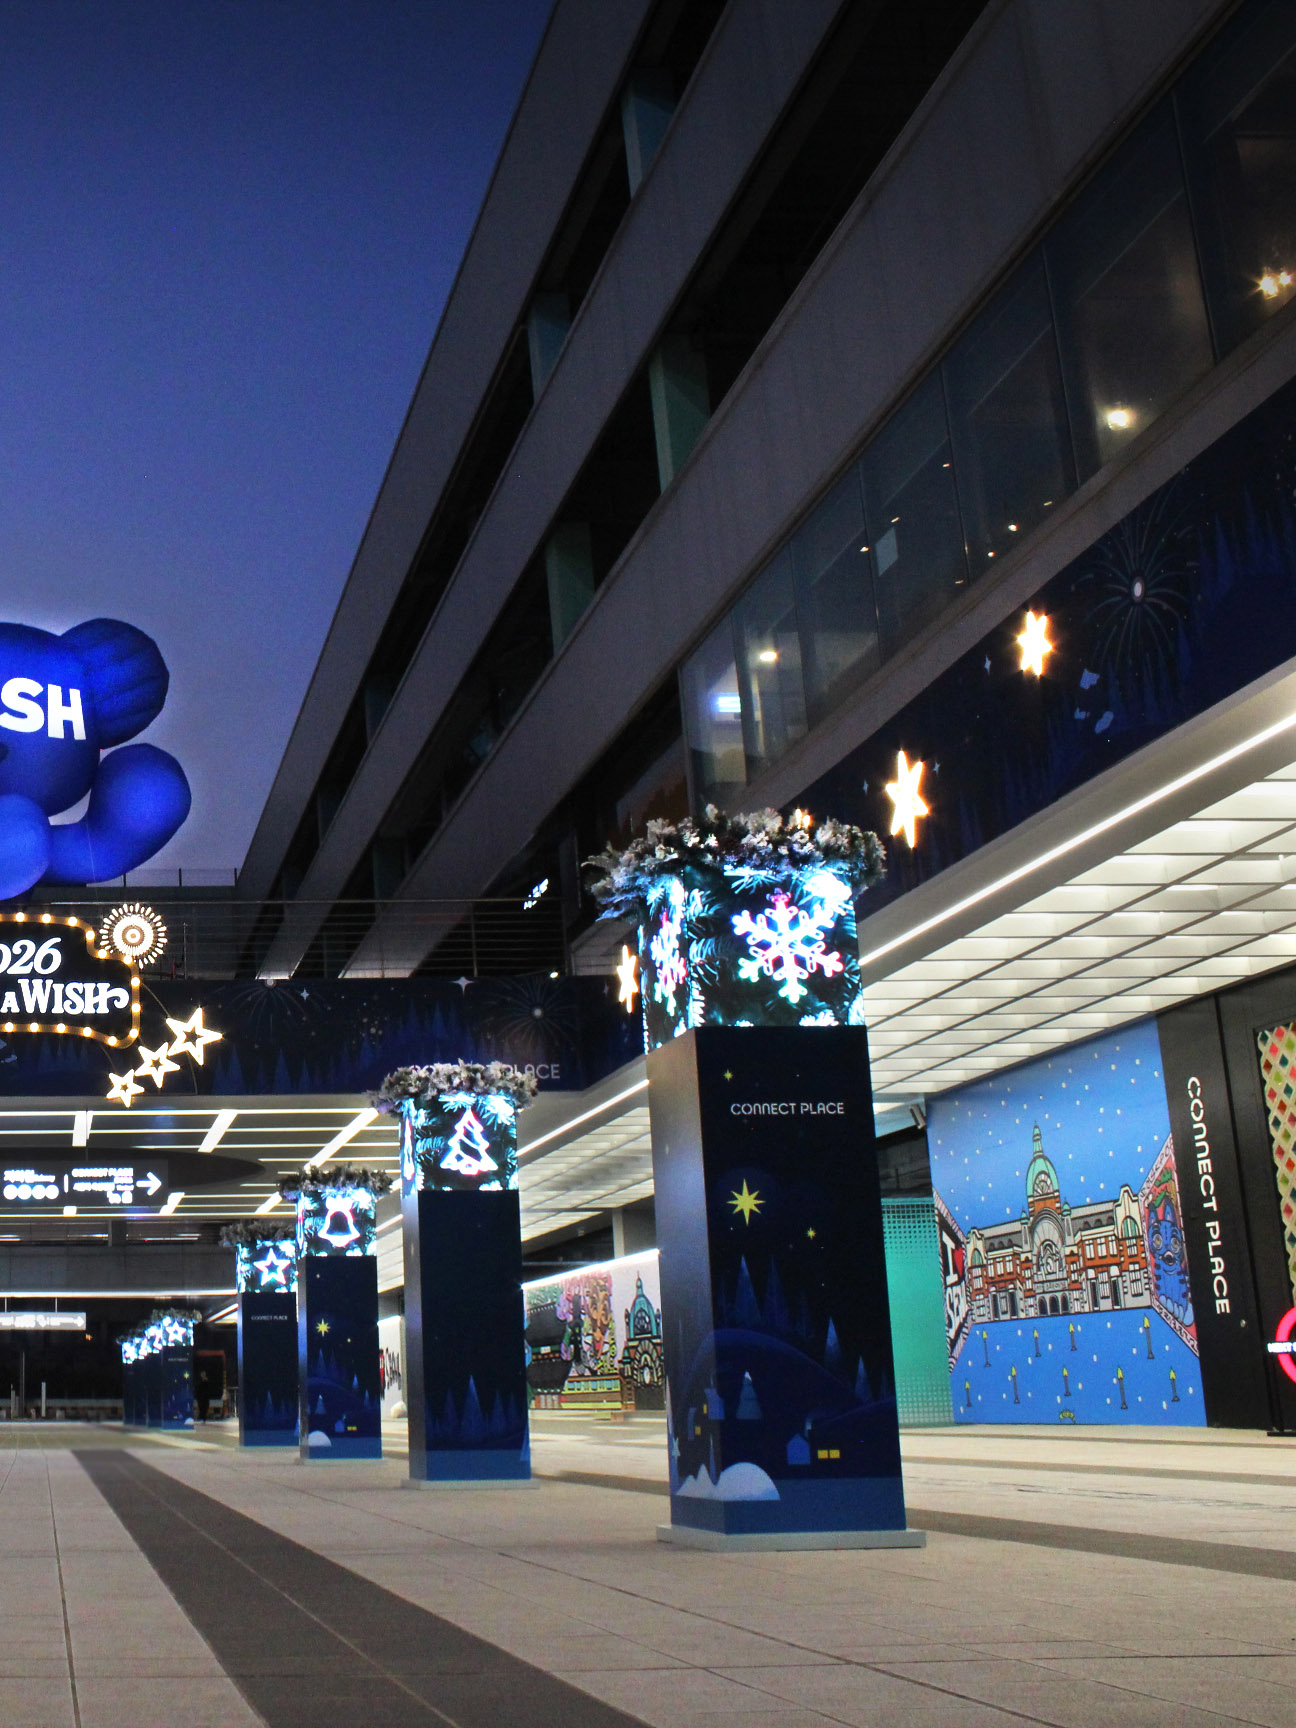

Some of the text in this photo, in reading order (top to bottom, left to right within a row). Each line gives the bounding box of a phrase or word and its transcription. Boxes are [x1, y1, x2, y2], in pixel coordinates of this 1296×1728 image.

[0, 991, 20, 1014] A
[17, 978, 130, 1015] WISH
[730, 1101, 845, 1116] CONNECT PLACE
[1187, 1076, 1231, 1315] CONNECT PLACE
